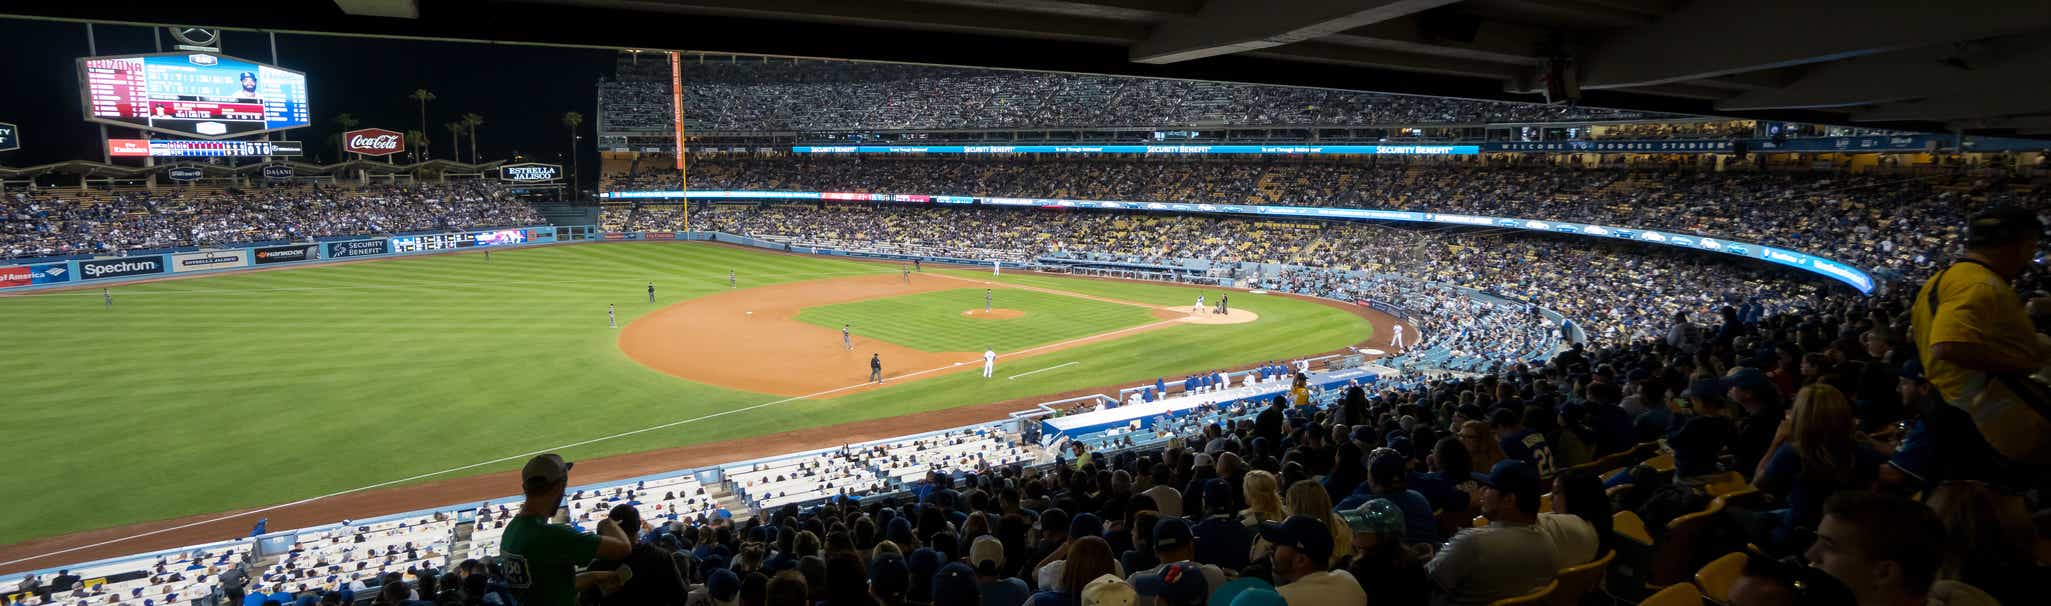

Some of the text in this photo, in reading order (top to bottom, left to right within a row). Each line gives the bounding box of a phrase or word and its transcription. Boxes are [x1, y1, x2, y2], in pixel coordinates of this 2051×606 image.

[350, 134, 399, 149] Coca-Cola
[1375, 145, 1414, 154] SECURITY
[508, 167, 555, 175] ESTRELLA
[348, 241, 384, 249] SECURITY
[349, 248, 380, 256] BENEFIT
[84, 261, 155, 277] Spectrum
[9, 271, 45, 281] America
